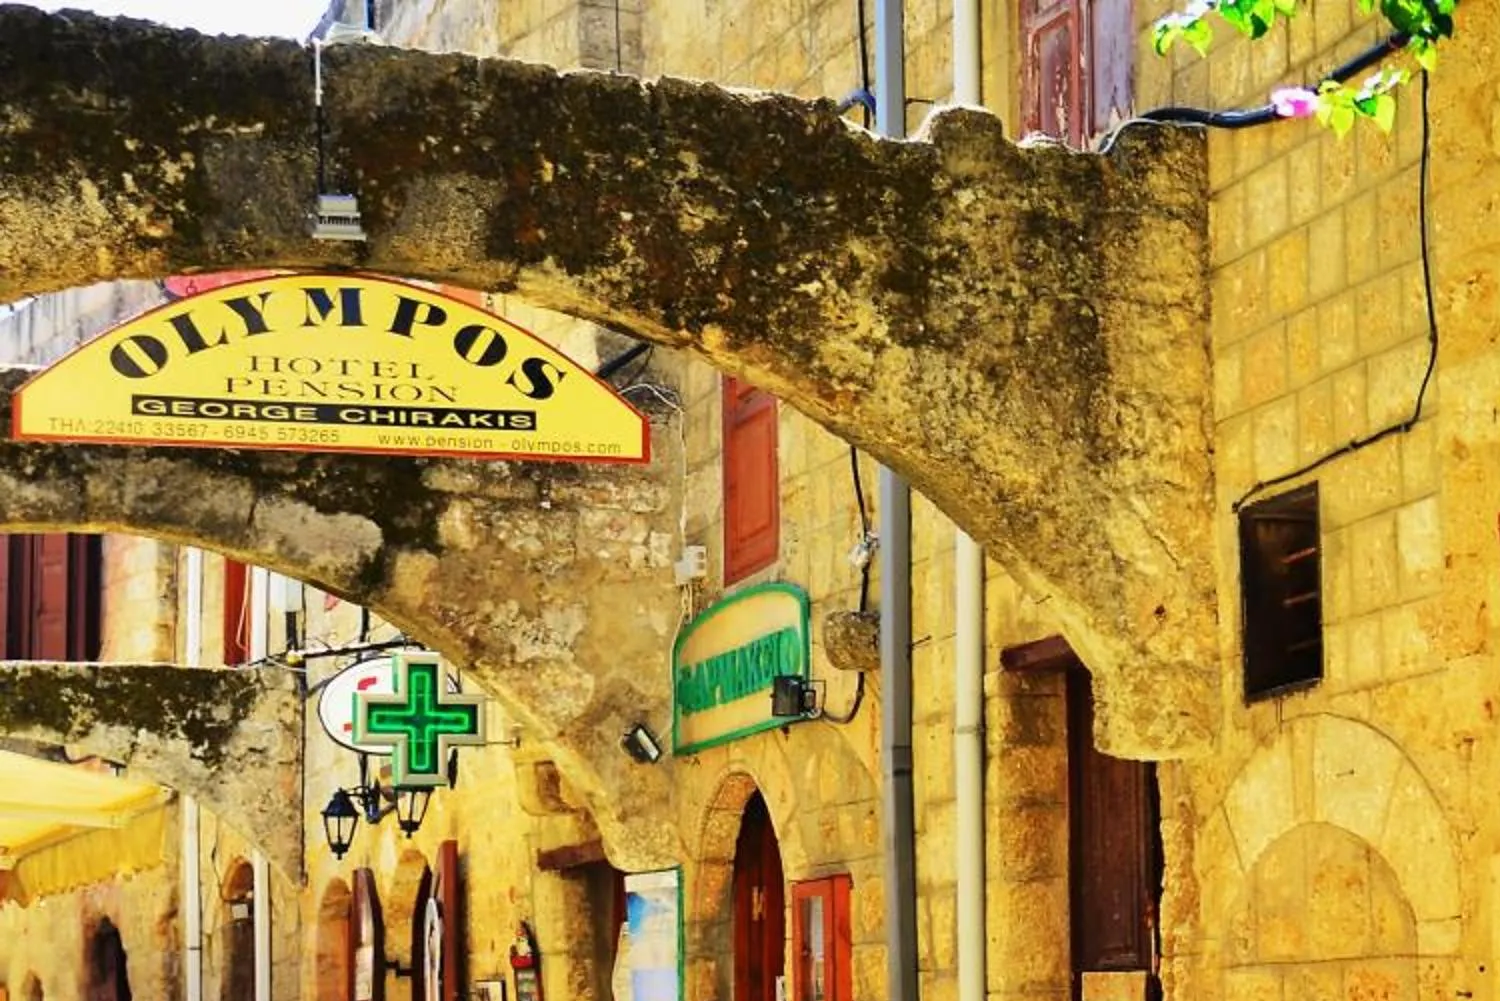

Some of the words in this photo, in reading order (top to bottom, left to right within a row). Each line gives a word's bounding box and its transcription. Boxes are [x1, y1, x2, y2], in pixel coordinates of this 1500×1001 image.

[110, 286, 568, 401] OLYMPOS
[249, 355, 436, 380] HOTEL
[225, 376, 457, 403] PENSION
[136, 399, 318, 422] GEORGE
[340, 407, 533, 429] CHIRAKIS
